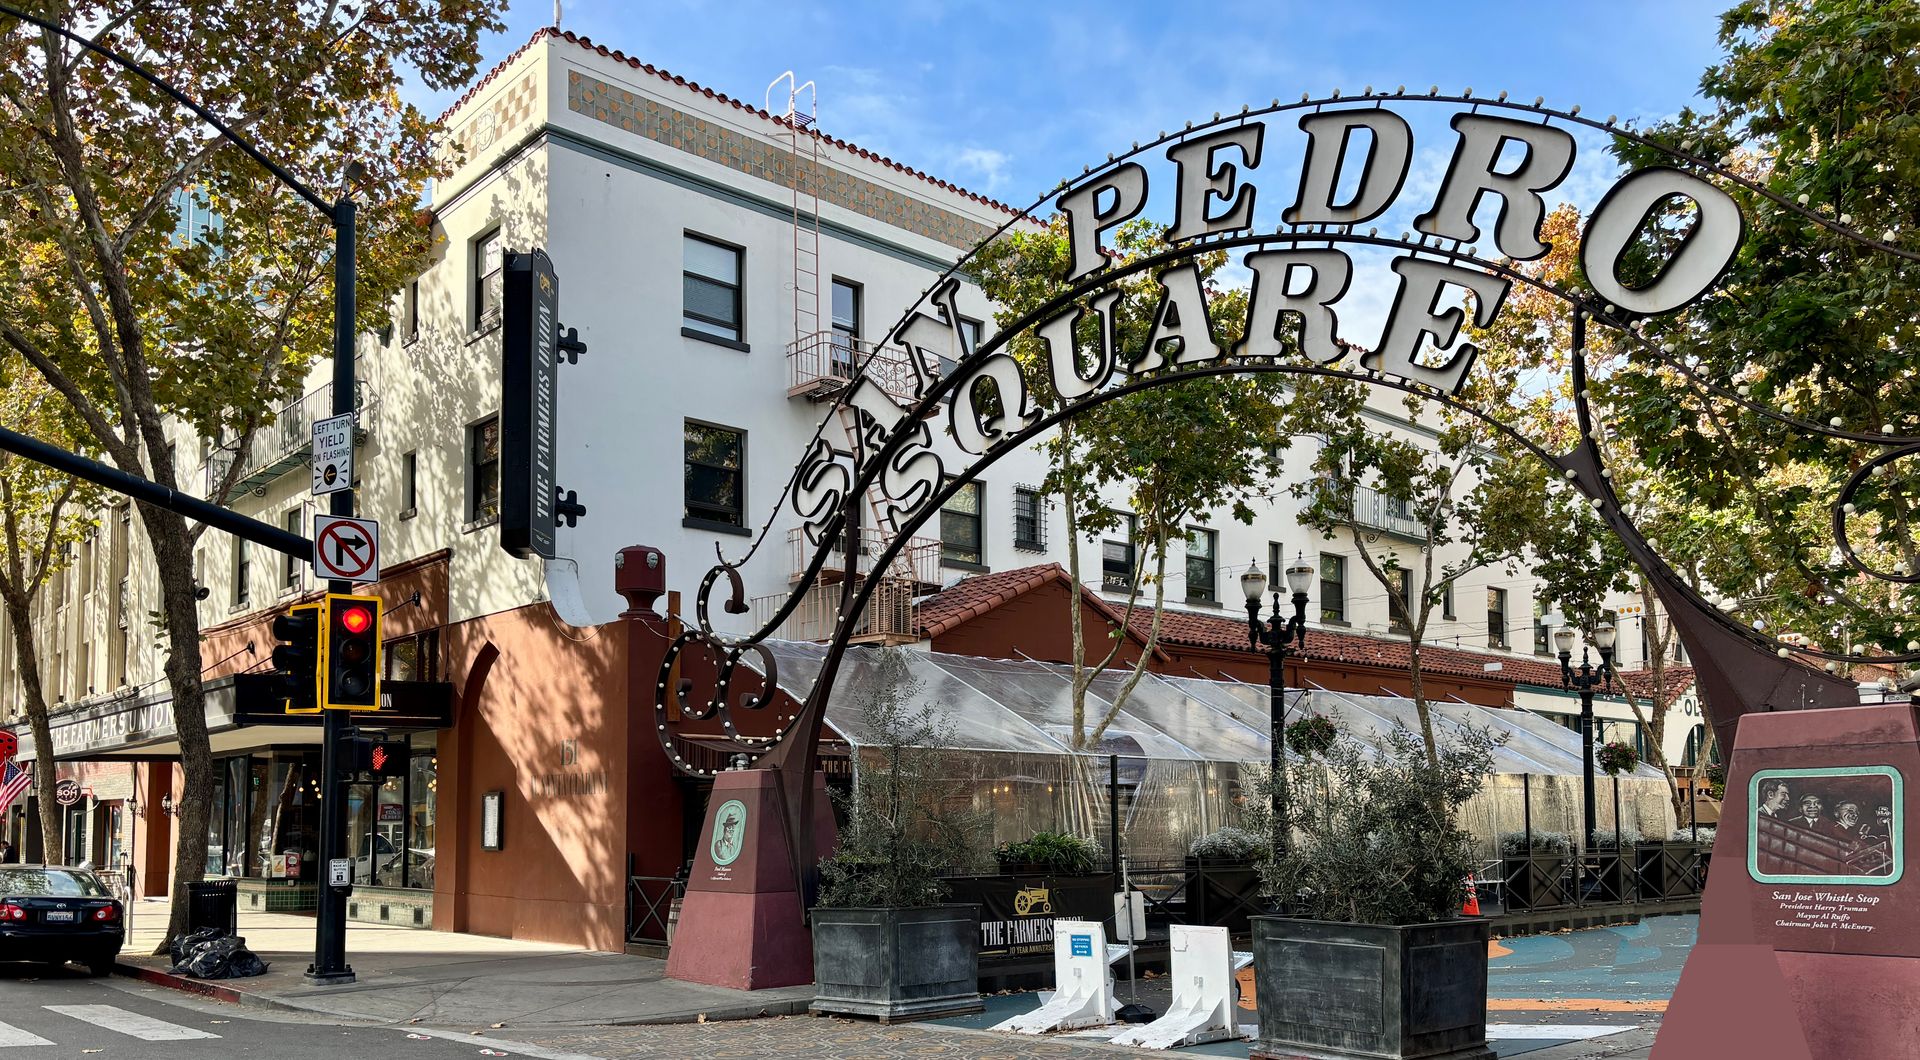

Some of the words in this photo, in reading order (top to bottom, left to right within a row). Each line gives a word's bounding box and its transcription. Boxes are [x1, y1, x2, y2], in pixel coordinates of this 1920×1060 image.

[538, 300, 551, 368] UNION
[792, 277, 969, 546] SAN
[1056, 108, 1744, 315] PEDRO
[880, 247, 1513, 536] SQUARE
[313, 423, 329, 435] LEFT
[331, 418, 350, 431] TURN
[537, 369, 550, 472] FARMERS
[319, 433, 345, 449] YIELD
[314, 454, 321, 463] ON
[322, 447, 350, 461] FLASHING
[536, 474, 549, 518] THE
[50, 726, 69, 747] THE
[70, 713, 125, 741] FARMERS
[128, 702, 175, 732] UNION
[822, 760, 839, 773] THE
[1772, 891, 1792, 901] San
[1793, 892, 1812, 902] Jose
[1814, 892, 1854, 903] Whistle
[1855, 894, 1880, 905] Stop
[1780, 903, 1813, 911] President
[1814, 904, 1836, 912] Harry
[1775, 920, 1811, 928] Chairman
[1811, 921, 1829, 929] John
[1796, 912, 1820, 920] Mayor
[1830, 913, 1851, 922] Ruffo
[981, 921, 1004, 946] THE
[1007, 918, 1053, 944] FARMERS
[1029, 944, 1055, 953] ANNIVERSA
